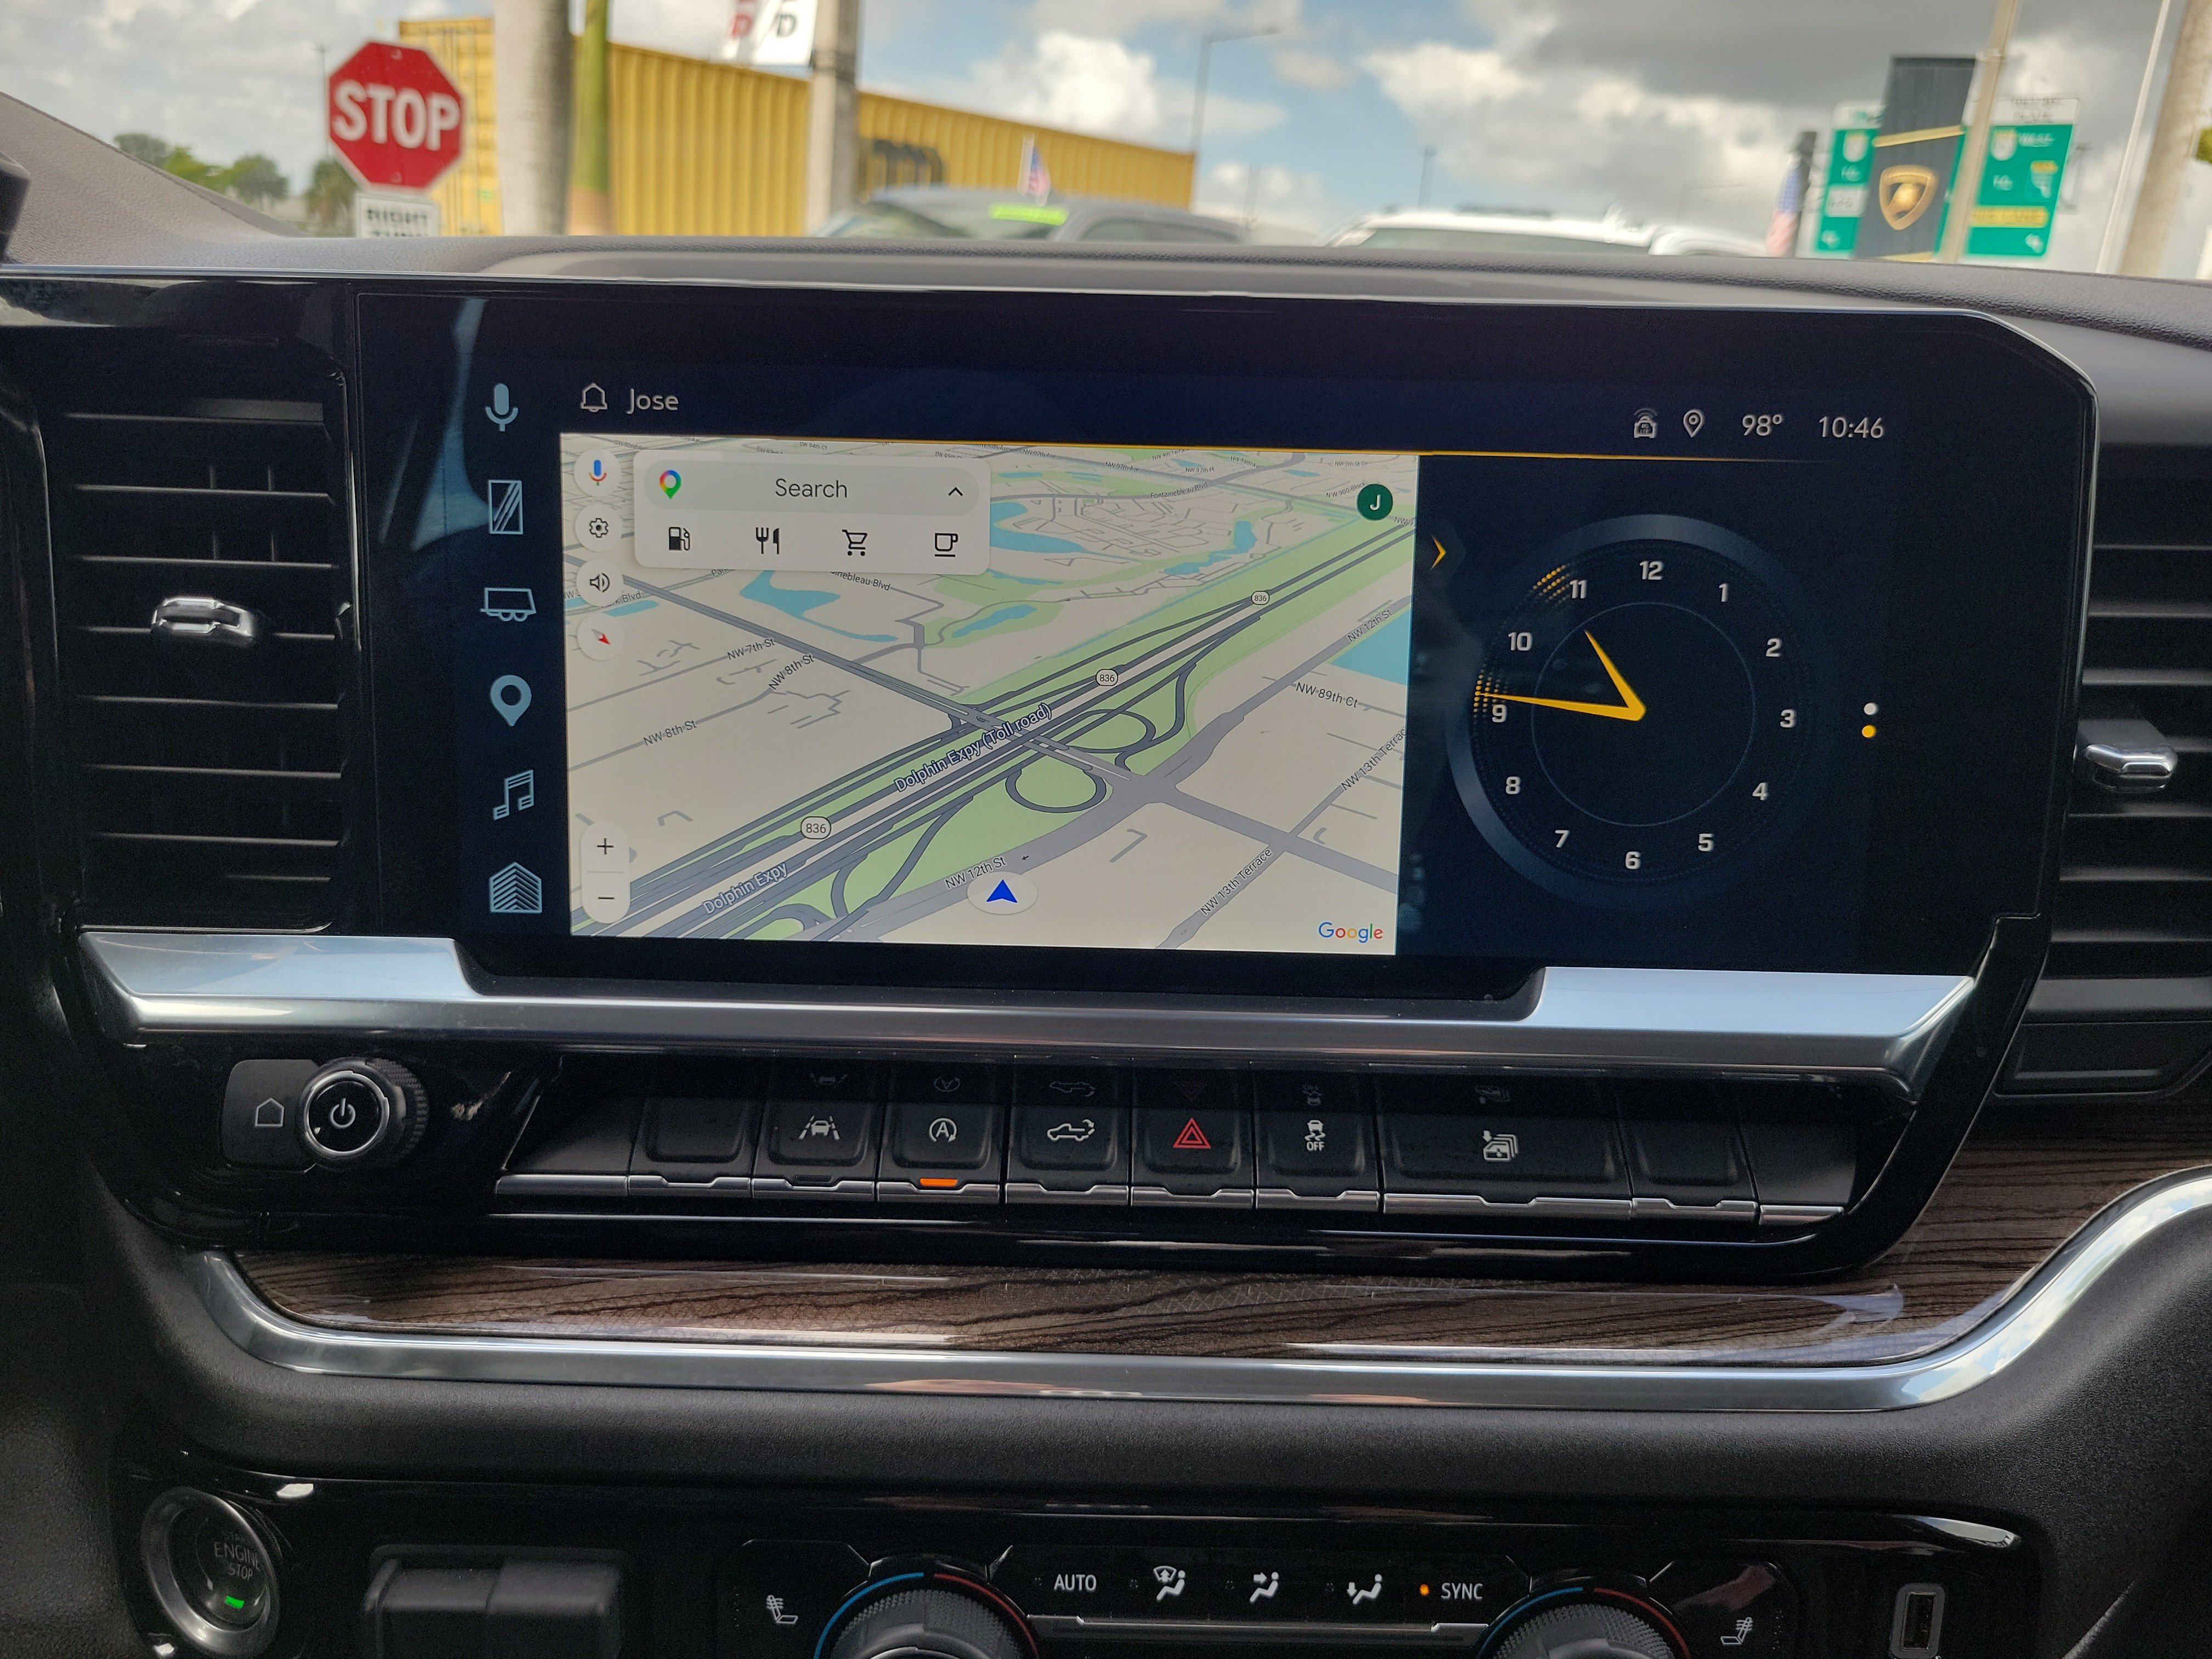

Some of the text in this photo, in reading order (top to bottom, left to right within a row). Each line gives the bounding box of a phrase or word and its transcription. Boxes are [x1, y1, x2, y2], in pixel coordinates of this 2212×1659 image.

[331, 78, 460, 151] STOP
[627, 389, 679, 414] Jose
[1742, 414, 1783, 437] 98°
[1819, 416, 1884, 438] 10:46
[775, 478, 848, 499] Search
[1150, 481, 1208, 499] Fontainebleau Blvd
[1338, 487, 1350, 496] 900
[1350, 481, 1367, 492] Block
[1369, 494, 1380, 510] J
[1393, 516, 1408, 525] NW
[1639, 561, 1663, 580] 12
[872, 579, 890, 591] Blvd
[1570, 580, 1587, 599] 11
[1719, 583, 1728, 602] 1
[622, 590, 642, 603] Blvd
[1347, 609, 1392, 642] NW 12th St
[727, 637, 776, 660] NW 7th St
[1508, 632, 1533, 651] 10
[1766, 639, 1781, 657] 2
[769, 653, 815, 690] NW 8th St
[1296, 682, 1358, 708] NW 89th Ct
[1492, 704, 1507, 723] 9
[1780, 709, 1797, 728] 3
[644, 720, 697, 746] NW 8th St
[894, 702, 1052, 792] Dolphin Expy (Toll road)
[1341, 772, 1359, 791] NW
[1358, 755, 1381, 775] 13th
[1505, 777, 1521, 794] 8
[1753, 783, 1769, 800] 4
[806, 823, 826, 833] 836
[1555, 830, 1570, 848] 7
[1698, 833, 1714, 851] 5
[1625, 851, 1641, 870] 6
[945, 856, 1006, 889] NW 12th St
[702, 862, 788, 915] Dolphin Expy
[1200, 849, 1272, 916] NW 13th Terrace
[1318, 922, 1384, 943] Google
[1306, 1142, 1325, 1151] OFF
[214, 1542, 261, 1571] ENGINE
[228, 1563, 252, 1581] STOP
[1054, 1574, 1097, 1592] AUTO
[1441, 1583, 1483, 1599] SYNC
